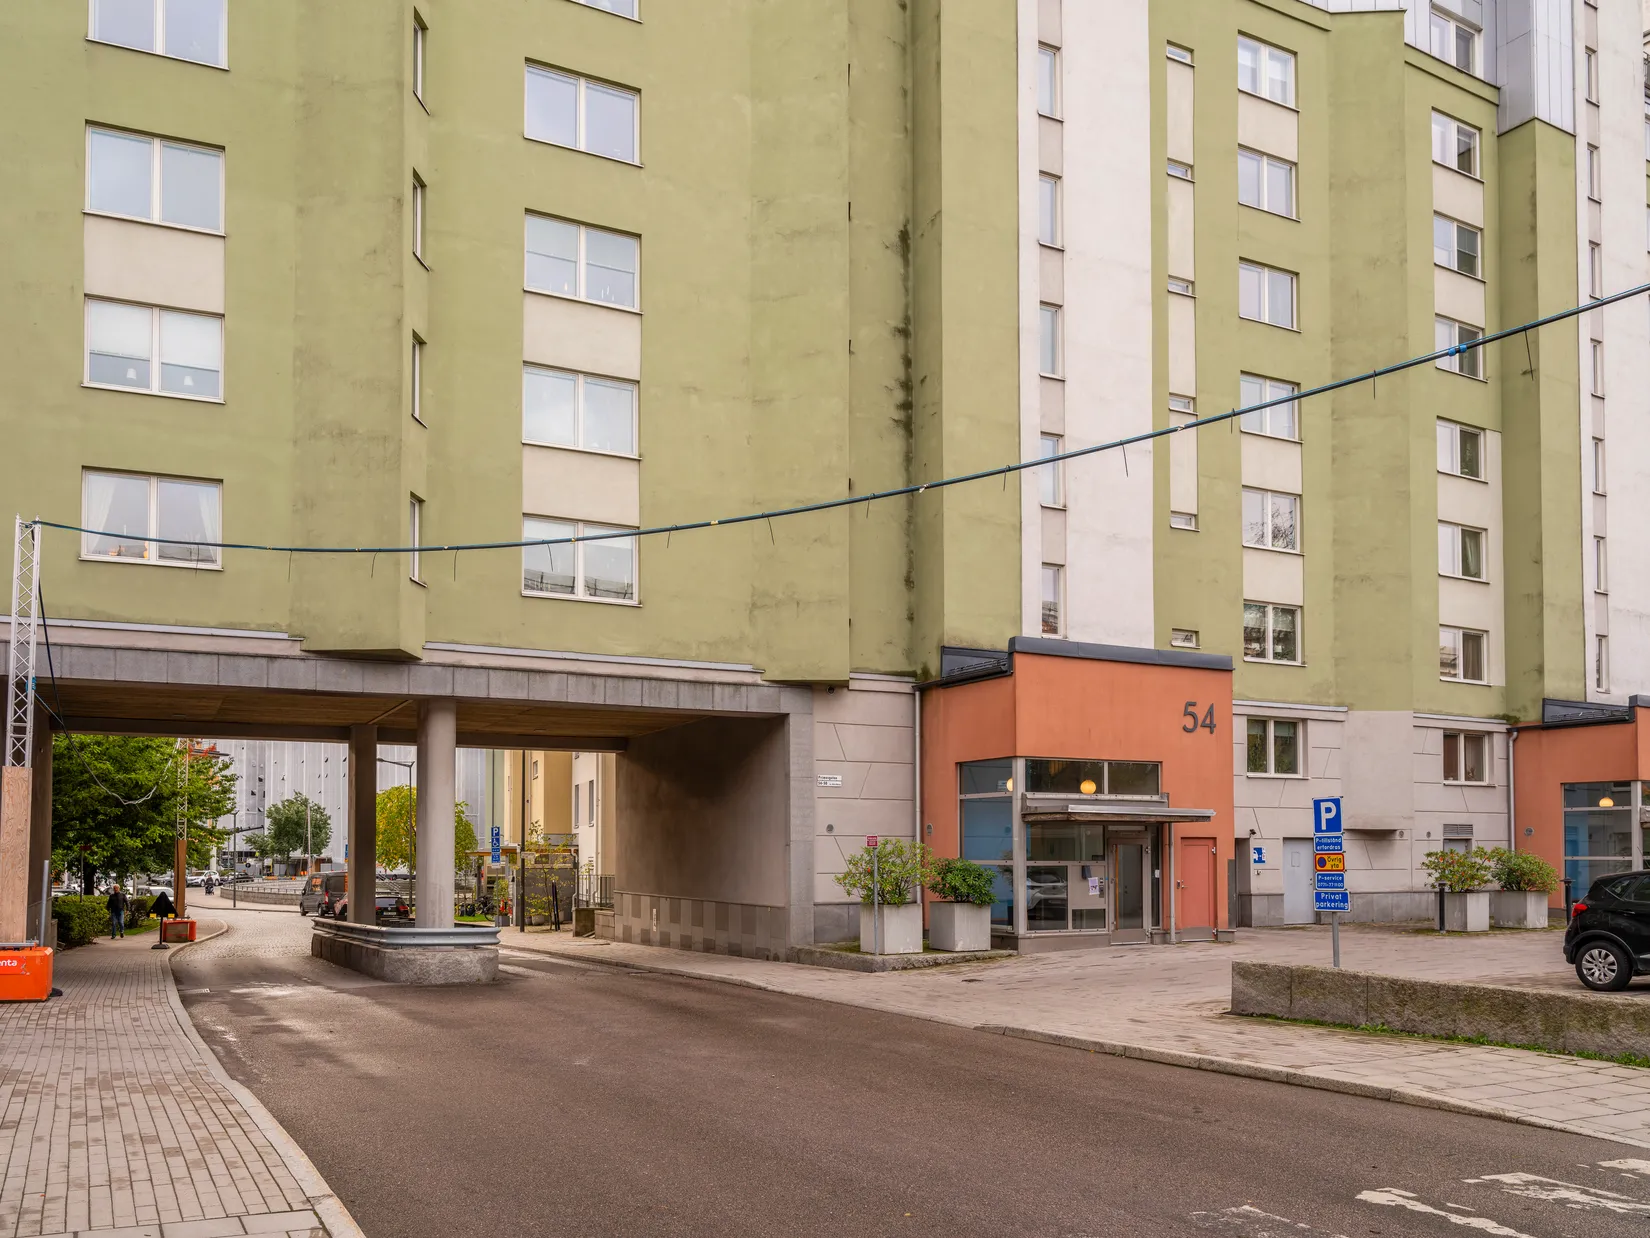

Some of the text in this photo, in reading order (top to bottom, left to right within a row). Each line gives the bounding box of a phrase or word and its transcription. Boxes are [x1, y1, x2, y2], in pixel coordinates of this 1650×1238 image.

[1183, 701, 1216, 734] 54
[1320, 801, 1337, 830] P
[1316, 901, 1349, 910] parkering
[0, 959, 18, 967] nta
